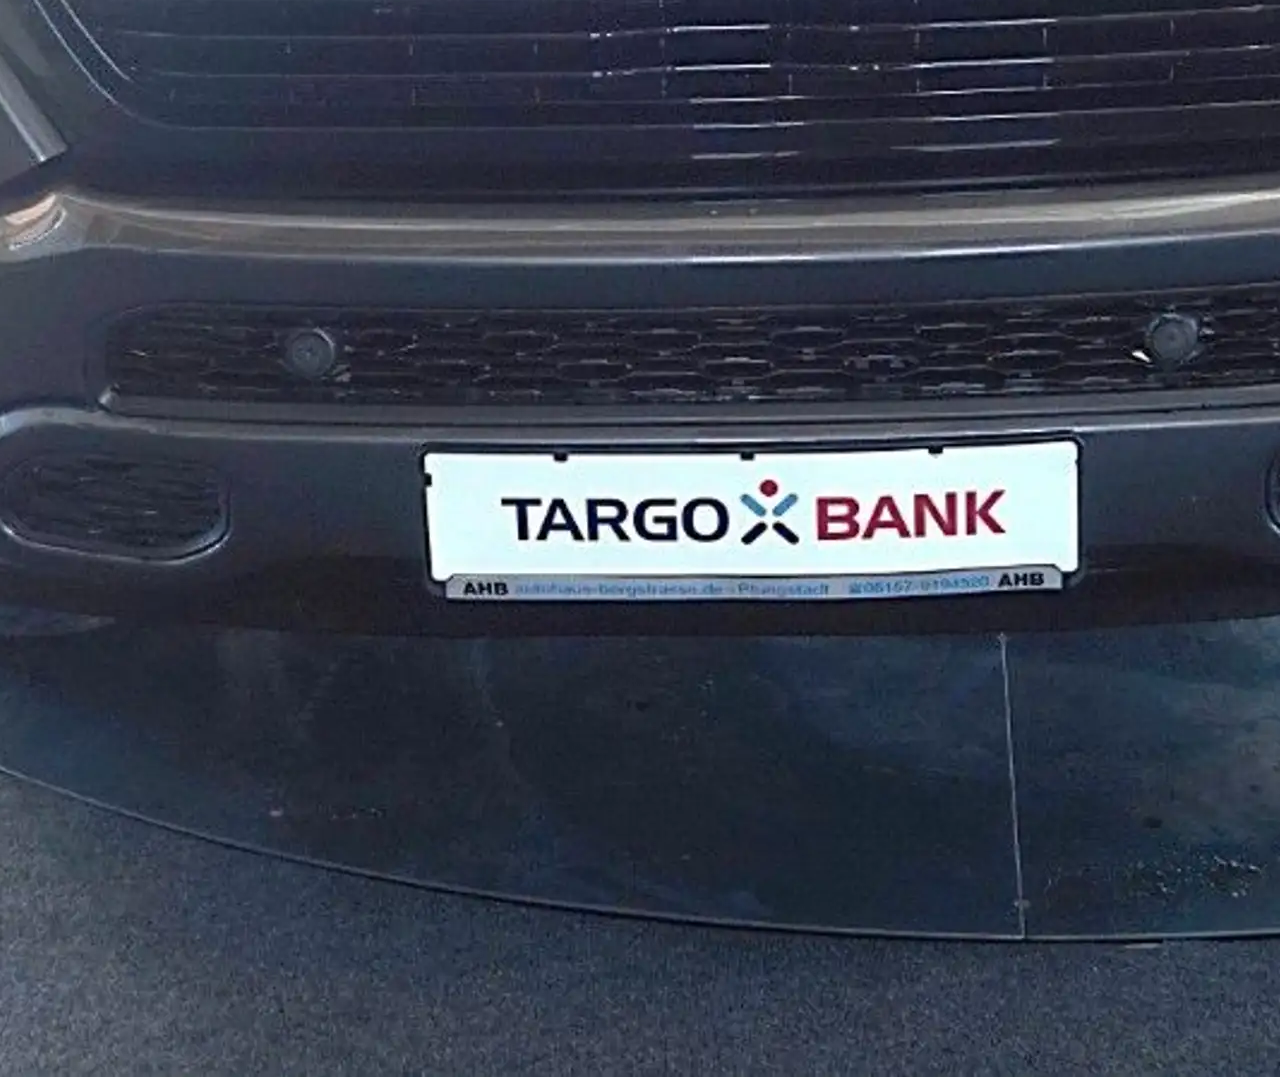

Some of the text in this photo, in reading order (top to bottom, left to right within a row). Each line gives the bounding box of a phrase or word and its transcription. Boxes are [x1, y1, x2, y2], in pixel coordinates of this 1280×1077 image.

[500, 489, 1006, 543] TARGO BANK
[463, 582, 508, 596] AHB
[998, 572, 1044, 588] AHB
